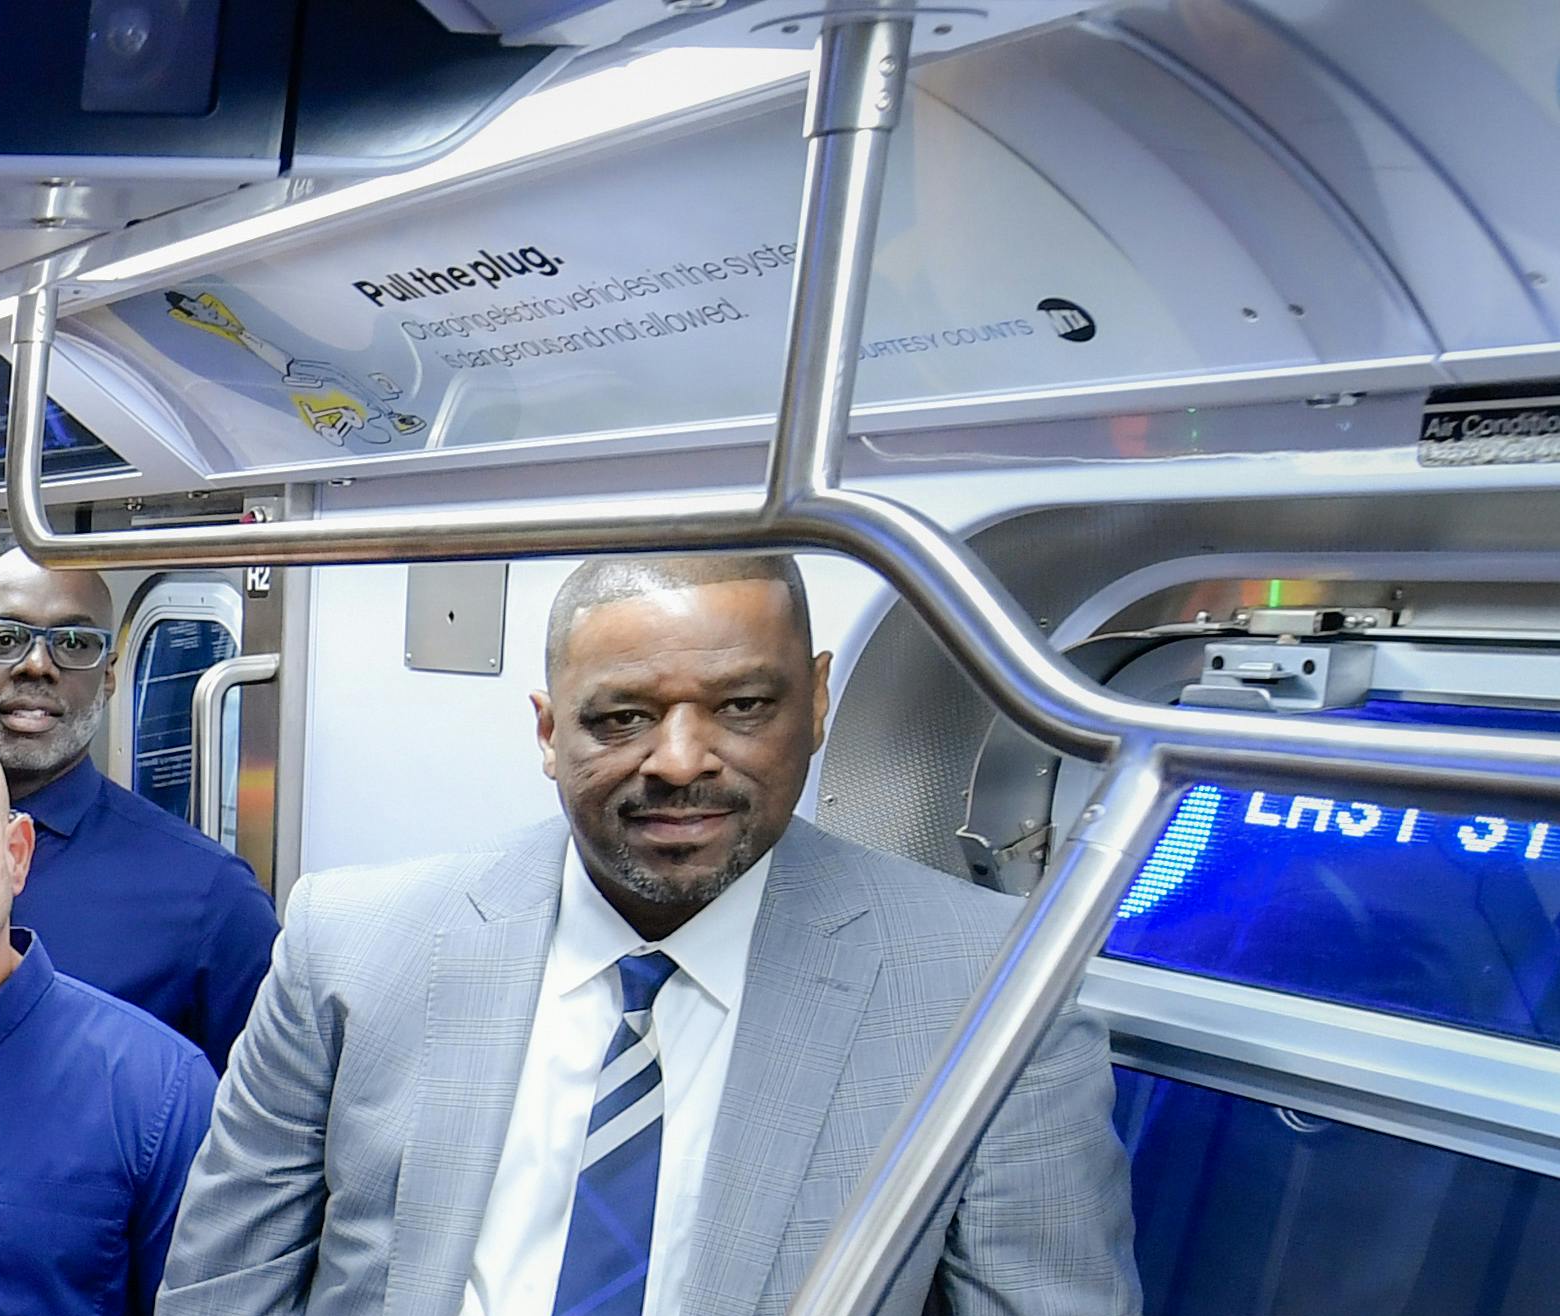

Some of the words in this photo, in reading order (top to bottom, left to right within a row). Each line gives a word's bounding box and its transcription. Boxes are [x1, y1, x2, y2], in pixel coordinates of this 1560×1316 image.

[353, 274, 426, 307] Pull
[409, 263, 477, 296] the
[468, 246, 565, 289] plug.
[401, 310, 497, 342] Charging
[486, 296, 565, 326] electric
[559, 275, 661, 312] vehicles
[646, 268, 674, 291] in
[674, 262, 728, 286] the
[723, 243, 798, 277] syste
[457, 335, 562, 368] dangerous
[557, 325, 604, 352] and
[599, 318, 645, 344] not
[639, 297, 750, 337] allowed.
[858, 334, 938, 361] URTESY
[942, 319, 1034, 346] COUNTS
[1424, 416, 1459, 438] Air
[1461, 410, 1560, 439] Conditio
[247, 567, 270, 591] R2
